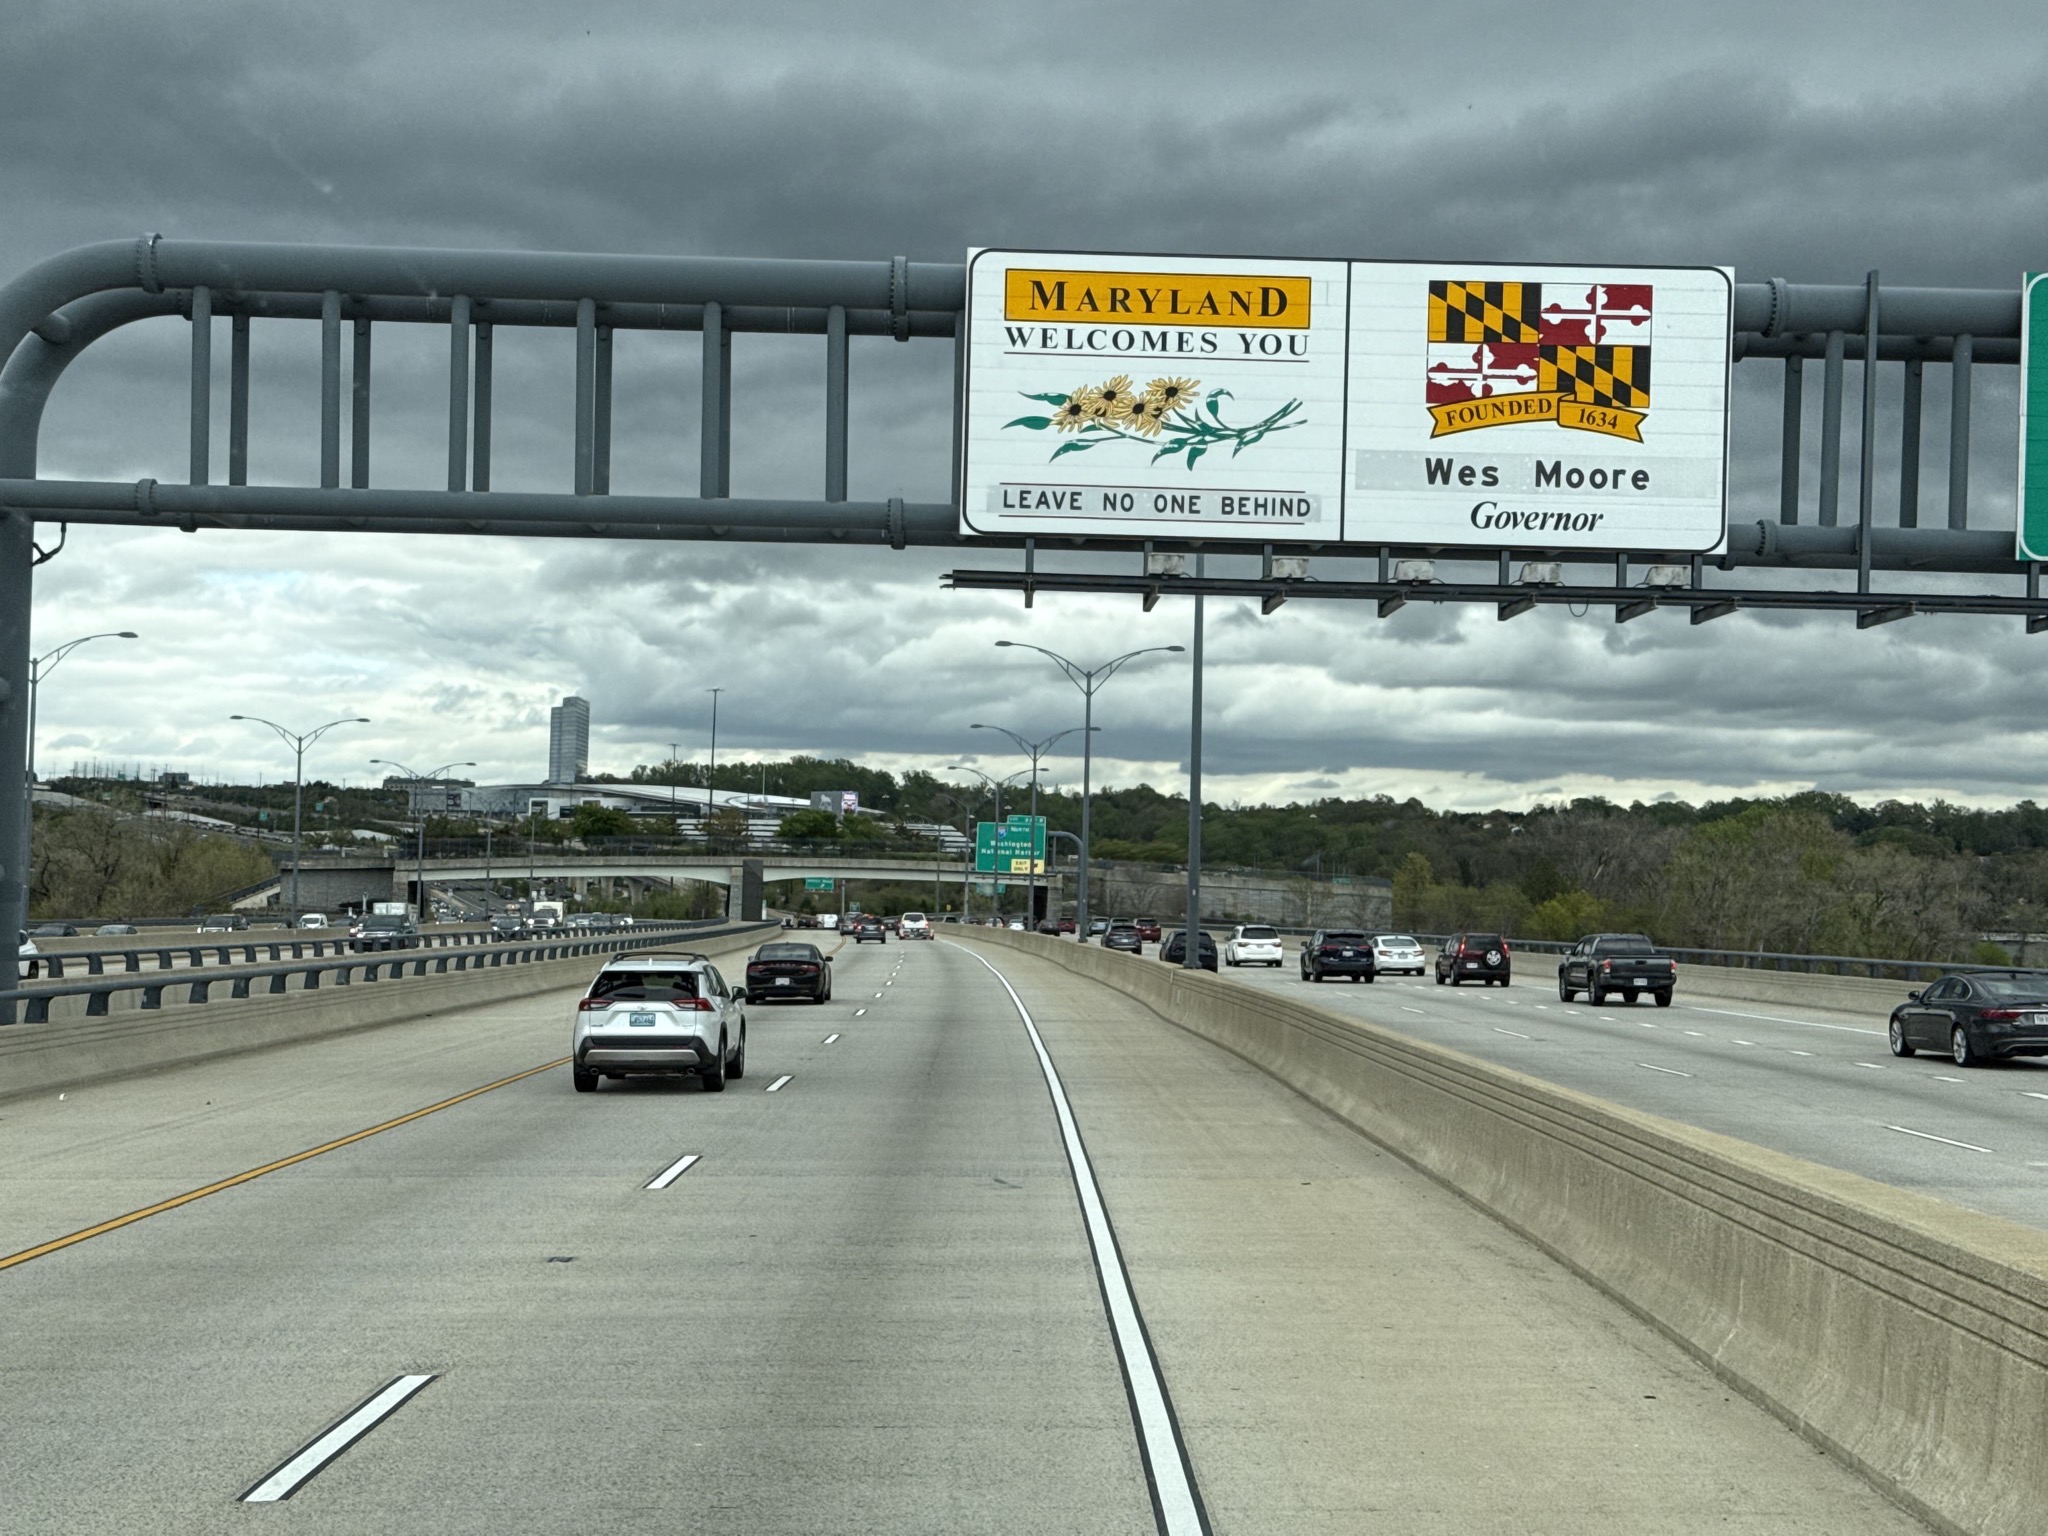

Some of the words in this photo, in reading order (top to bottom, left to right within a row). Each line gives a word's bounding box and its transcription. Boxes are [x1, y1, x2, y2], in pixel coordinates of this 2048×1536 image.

[1028, 280, 1289, 317] MARYLAND
[1004, 326, 1219, 353] WELCOMES
[1237, 333, 1310, 356] YOU
[1445, 398, 1553, 427] FOUNDED
[1577, 407, 1618, 429] 1634
[1425, 457, 1500, 486] Wes
[1534, 460, 1650, 491] Moore
[1003, 489, 1083, 510] LEAVE
[1103, 492, 1134, 512] NO
[1153, 494, 1201, 514] ONE
[1221, 496, 1311, 517] BEHIND
[1470, 501, 1604, 532] Governor
